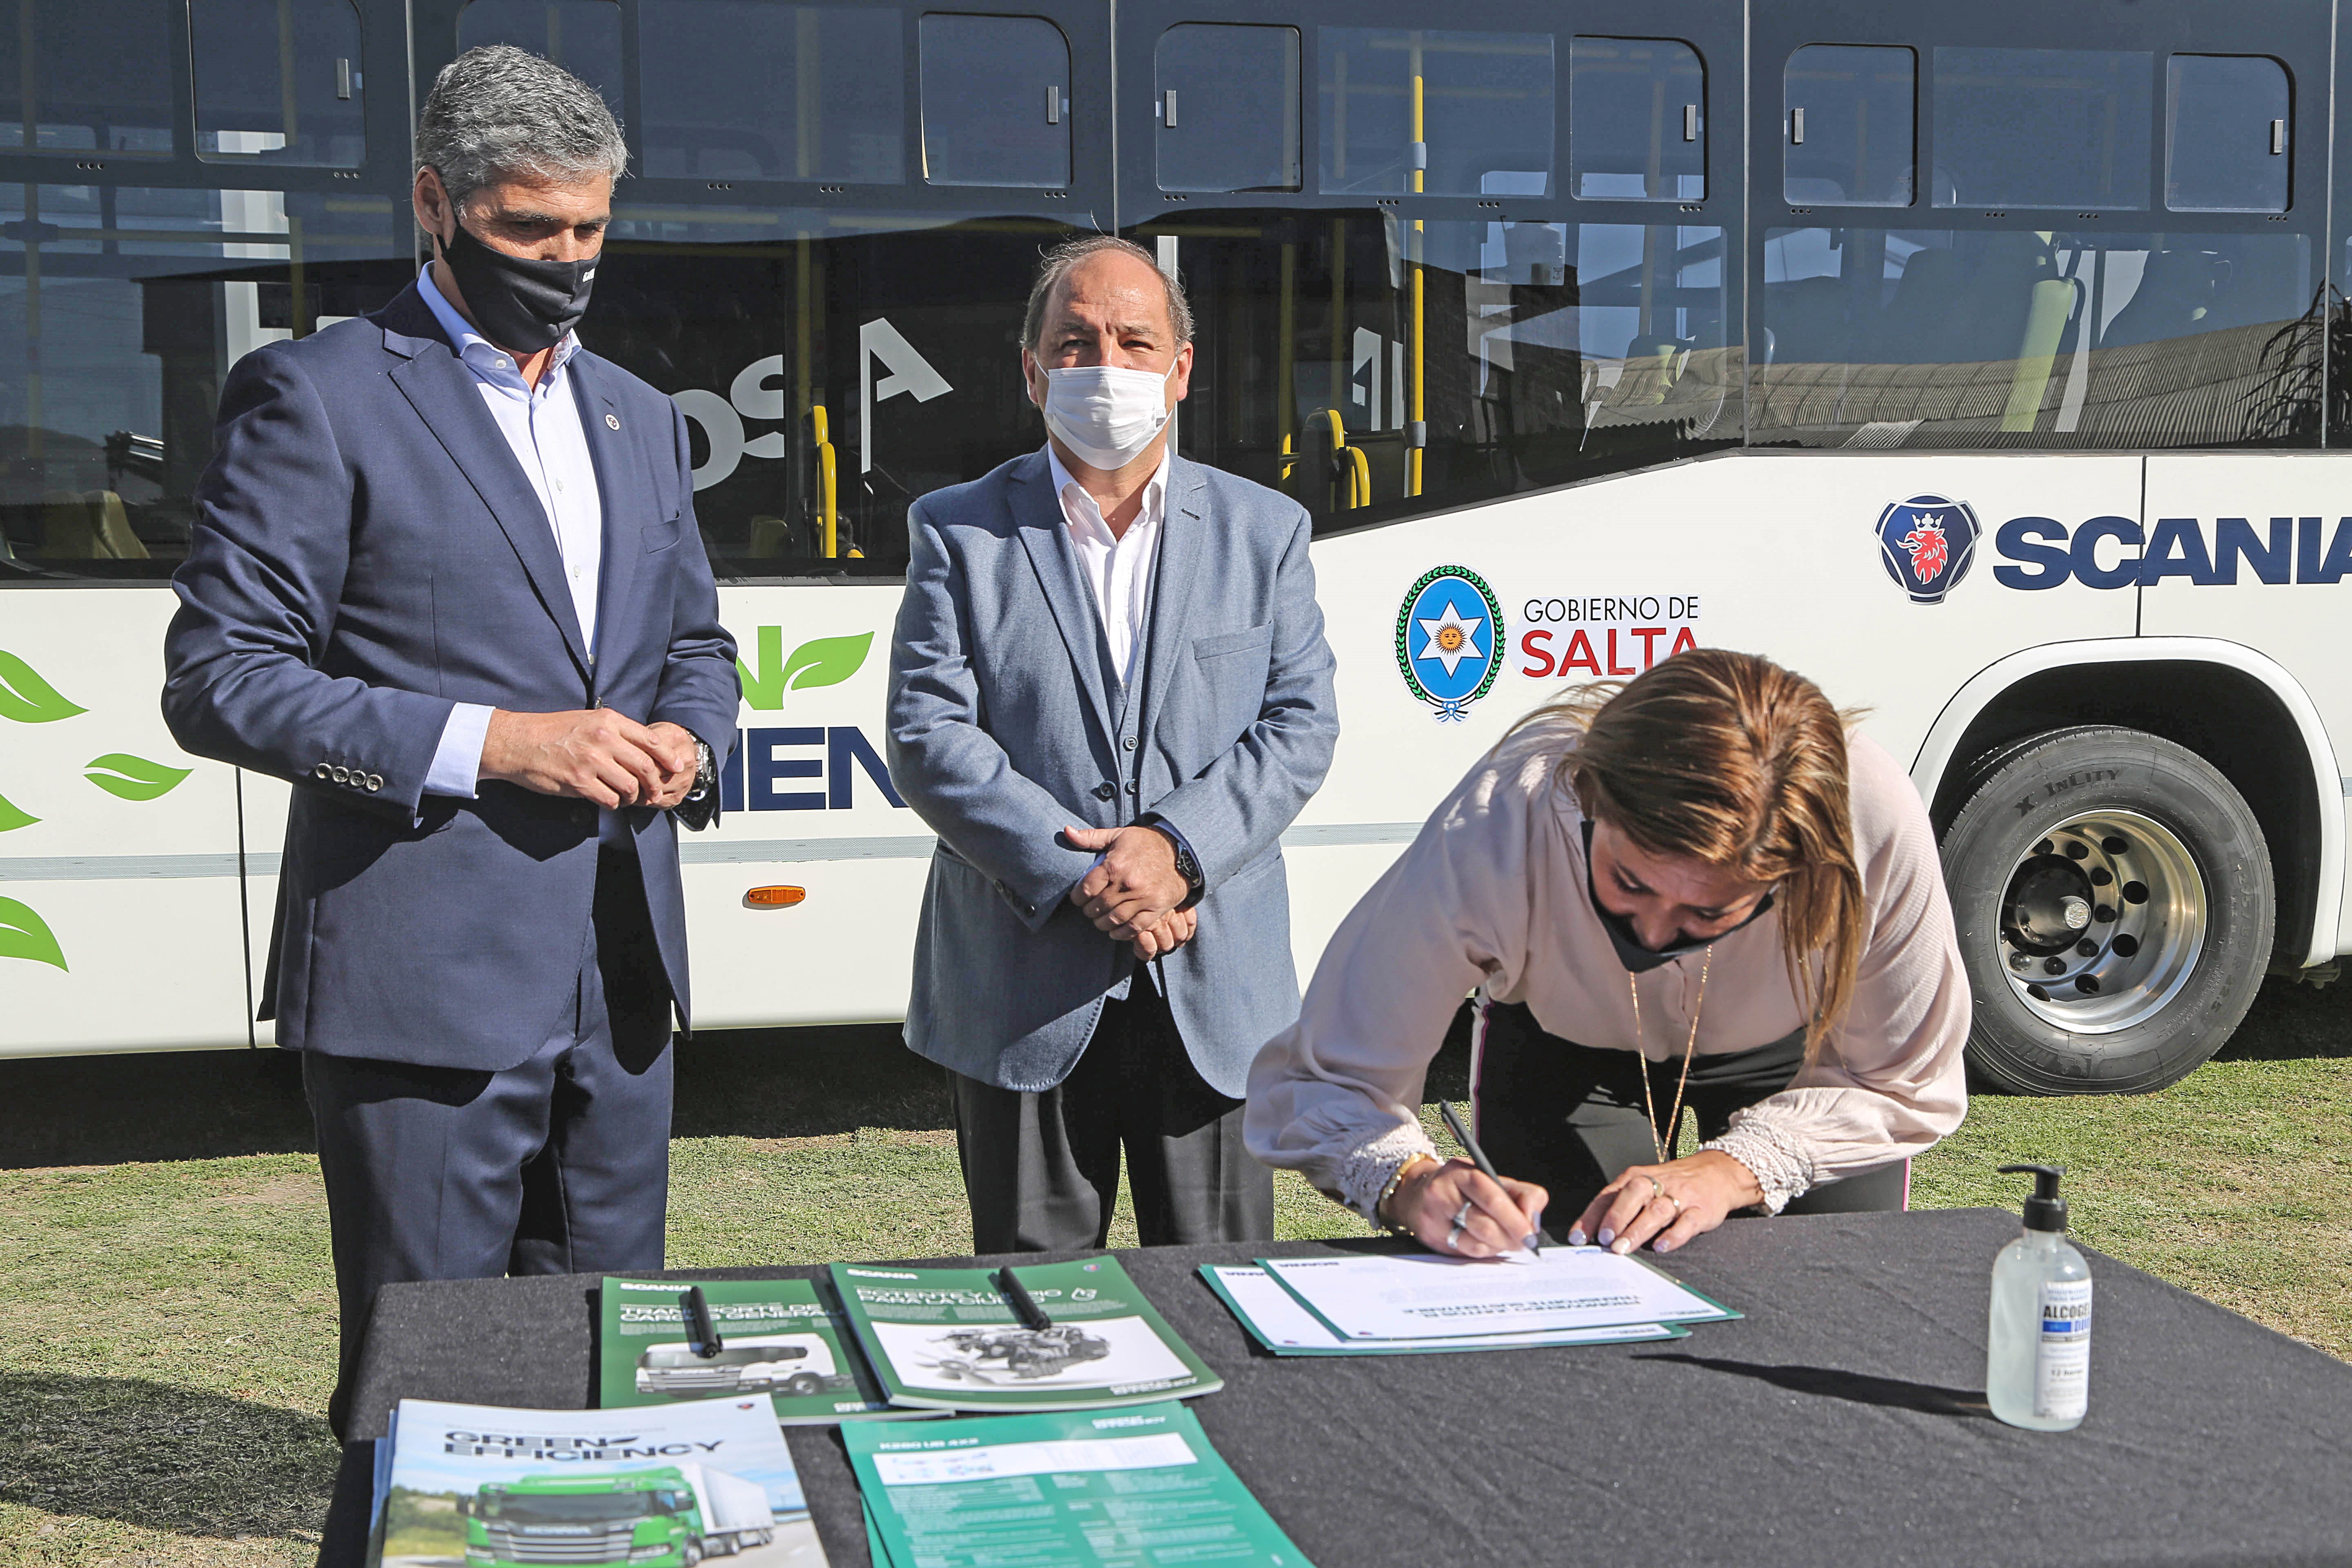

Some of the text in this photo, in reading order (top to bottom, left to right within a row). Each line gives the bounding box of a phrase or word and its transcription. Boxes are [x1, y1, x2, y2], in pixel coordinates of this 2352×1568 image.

[1524, 597, 1698, 622] GOBIERNO DE
[847, 1269, 918, 1279] SCANIA
[620, 1283, 693, 1292] SCANIA
[445, 1430, 608, 1448] GREEN
[444, 1438, 724, 1462] EFFICIENCY
